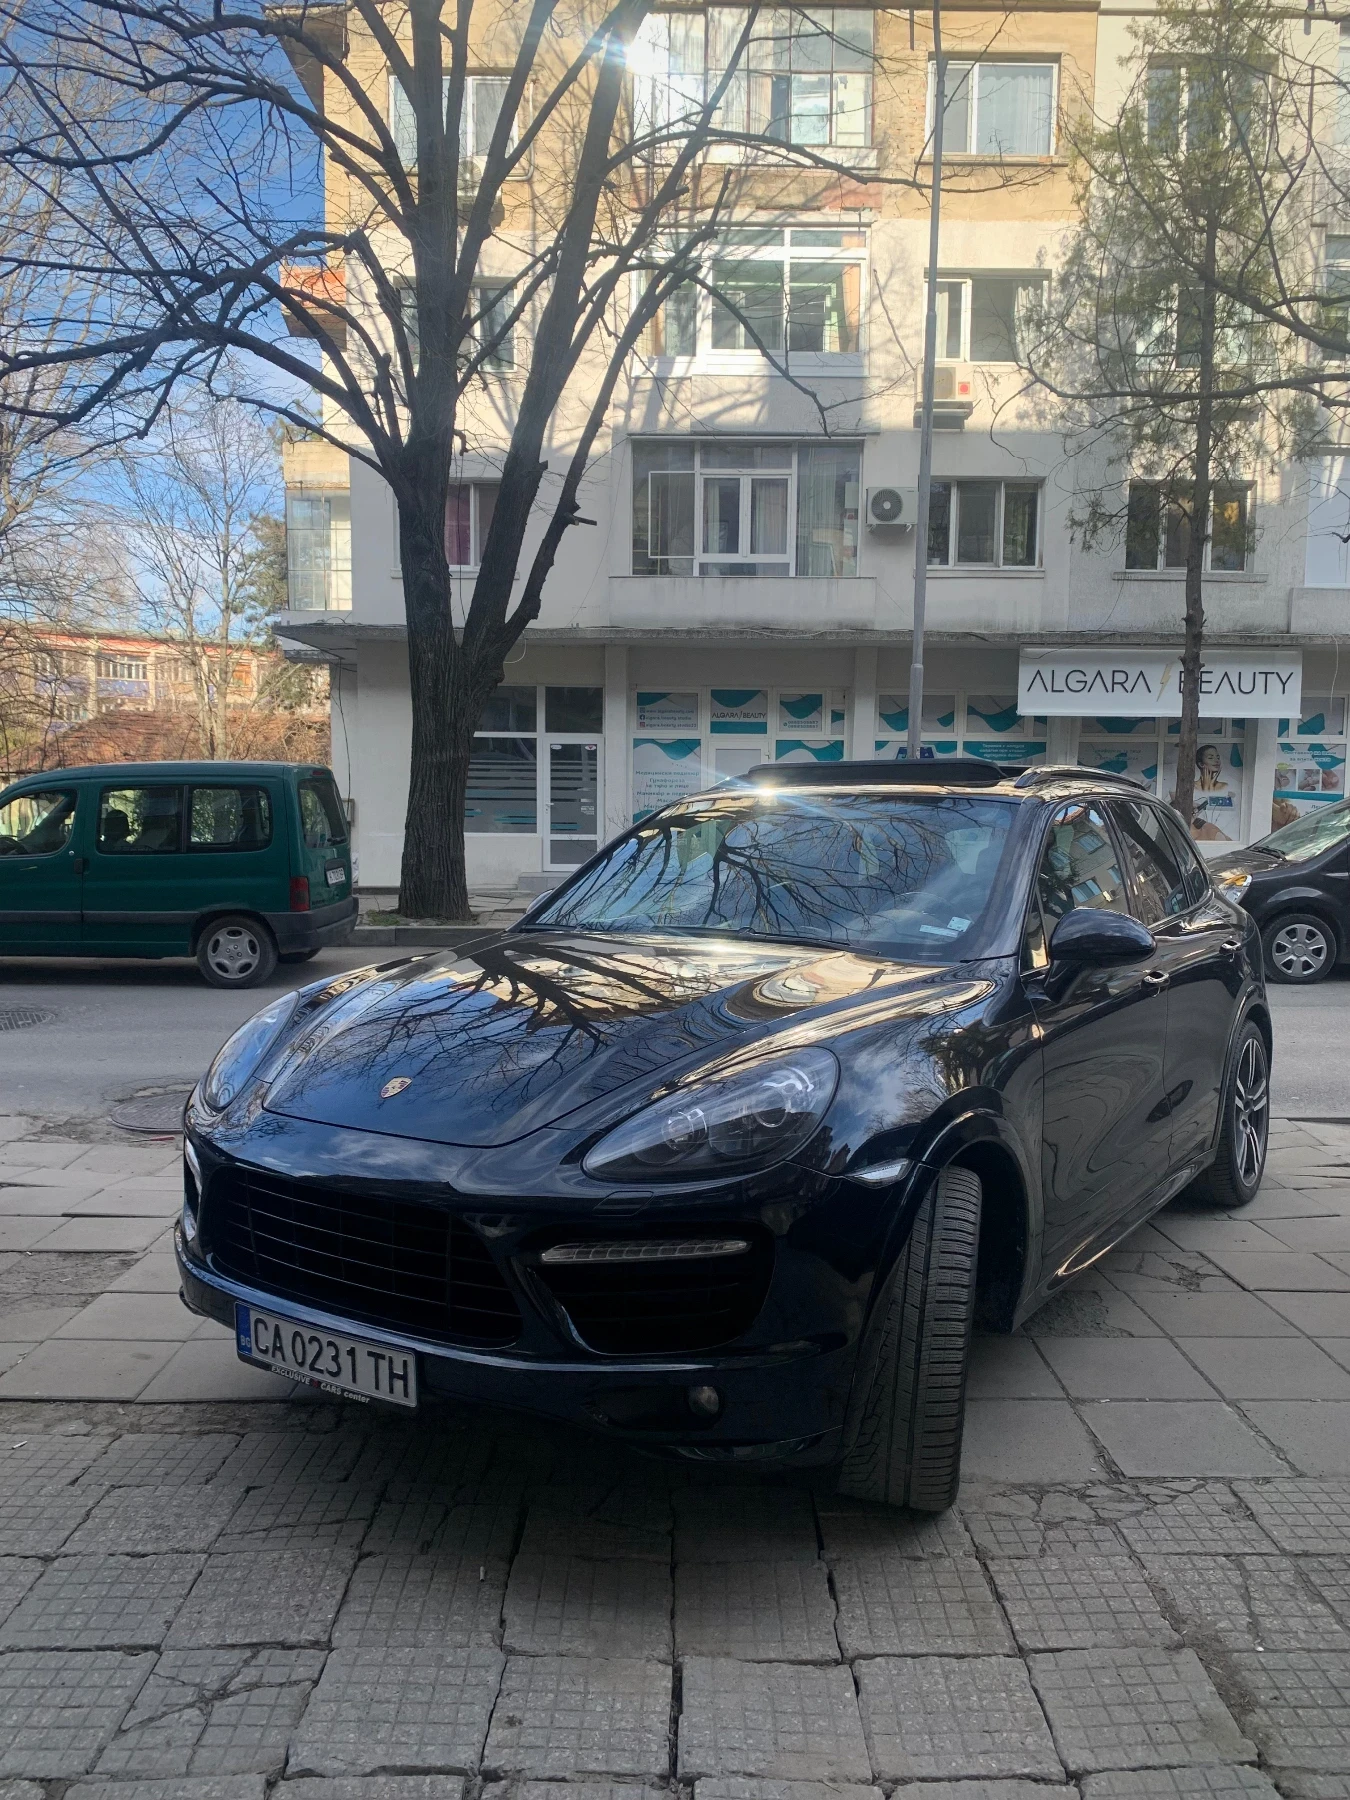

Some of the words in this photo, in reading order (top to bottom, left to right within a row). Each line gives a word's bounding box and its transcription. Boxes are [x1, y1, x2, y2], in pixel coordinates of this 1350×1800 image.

[1026, 669, 1152, 693] ALGARA
[1178, 670, 1294, 695] EAUTY
[711, 711, 739, 719] ALGARA
[240, 1334, 251, 1348] BG
[254, 1317, 286, 1362] CA
[291, 1330, 357, 1384] 0231
[367, 1350, 409, 1399] TH
[271, 1366, 310, 1386] EXCLUSIVE
[320, 1382, 342, 1396] CARS
[343, 1390, 370, 1404] center
